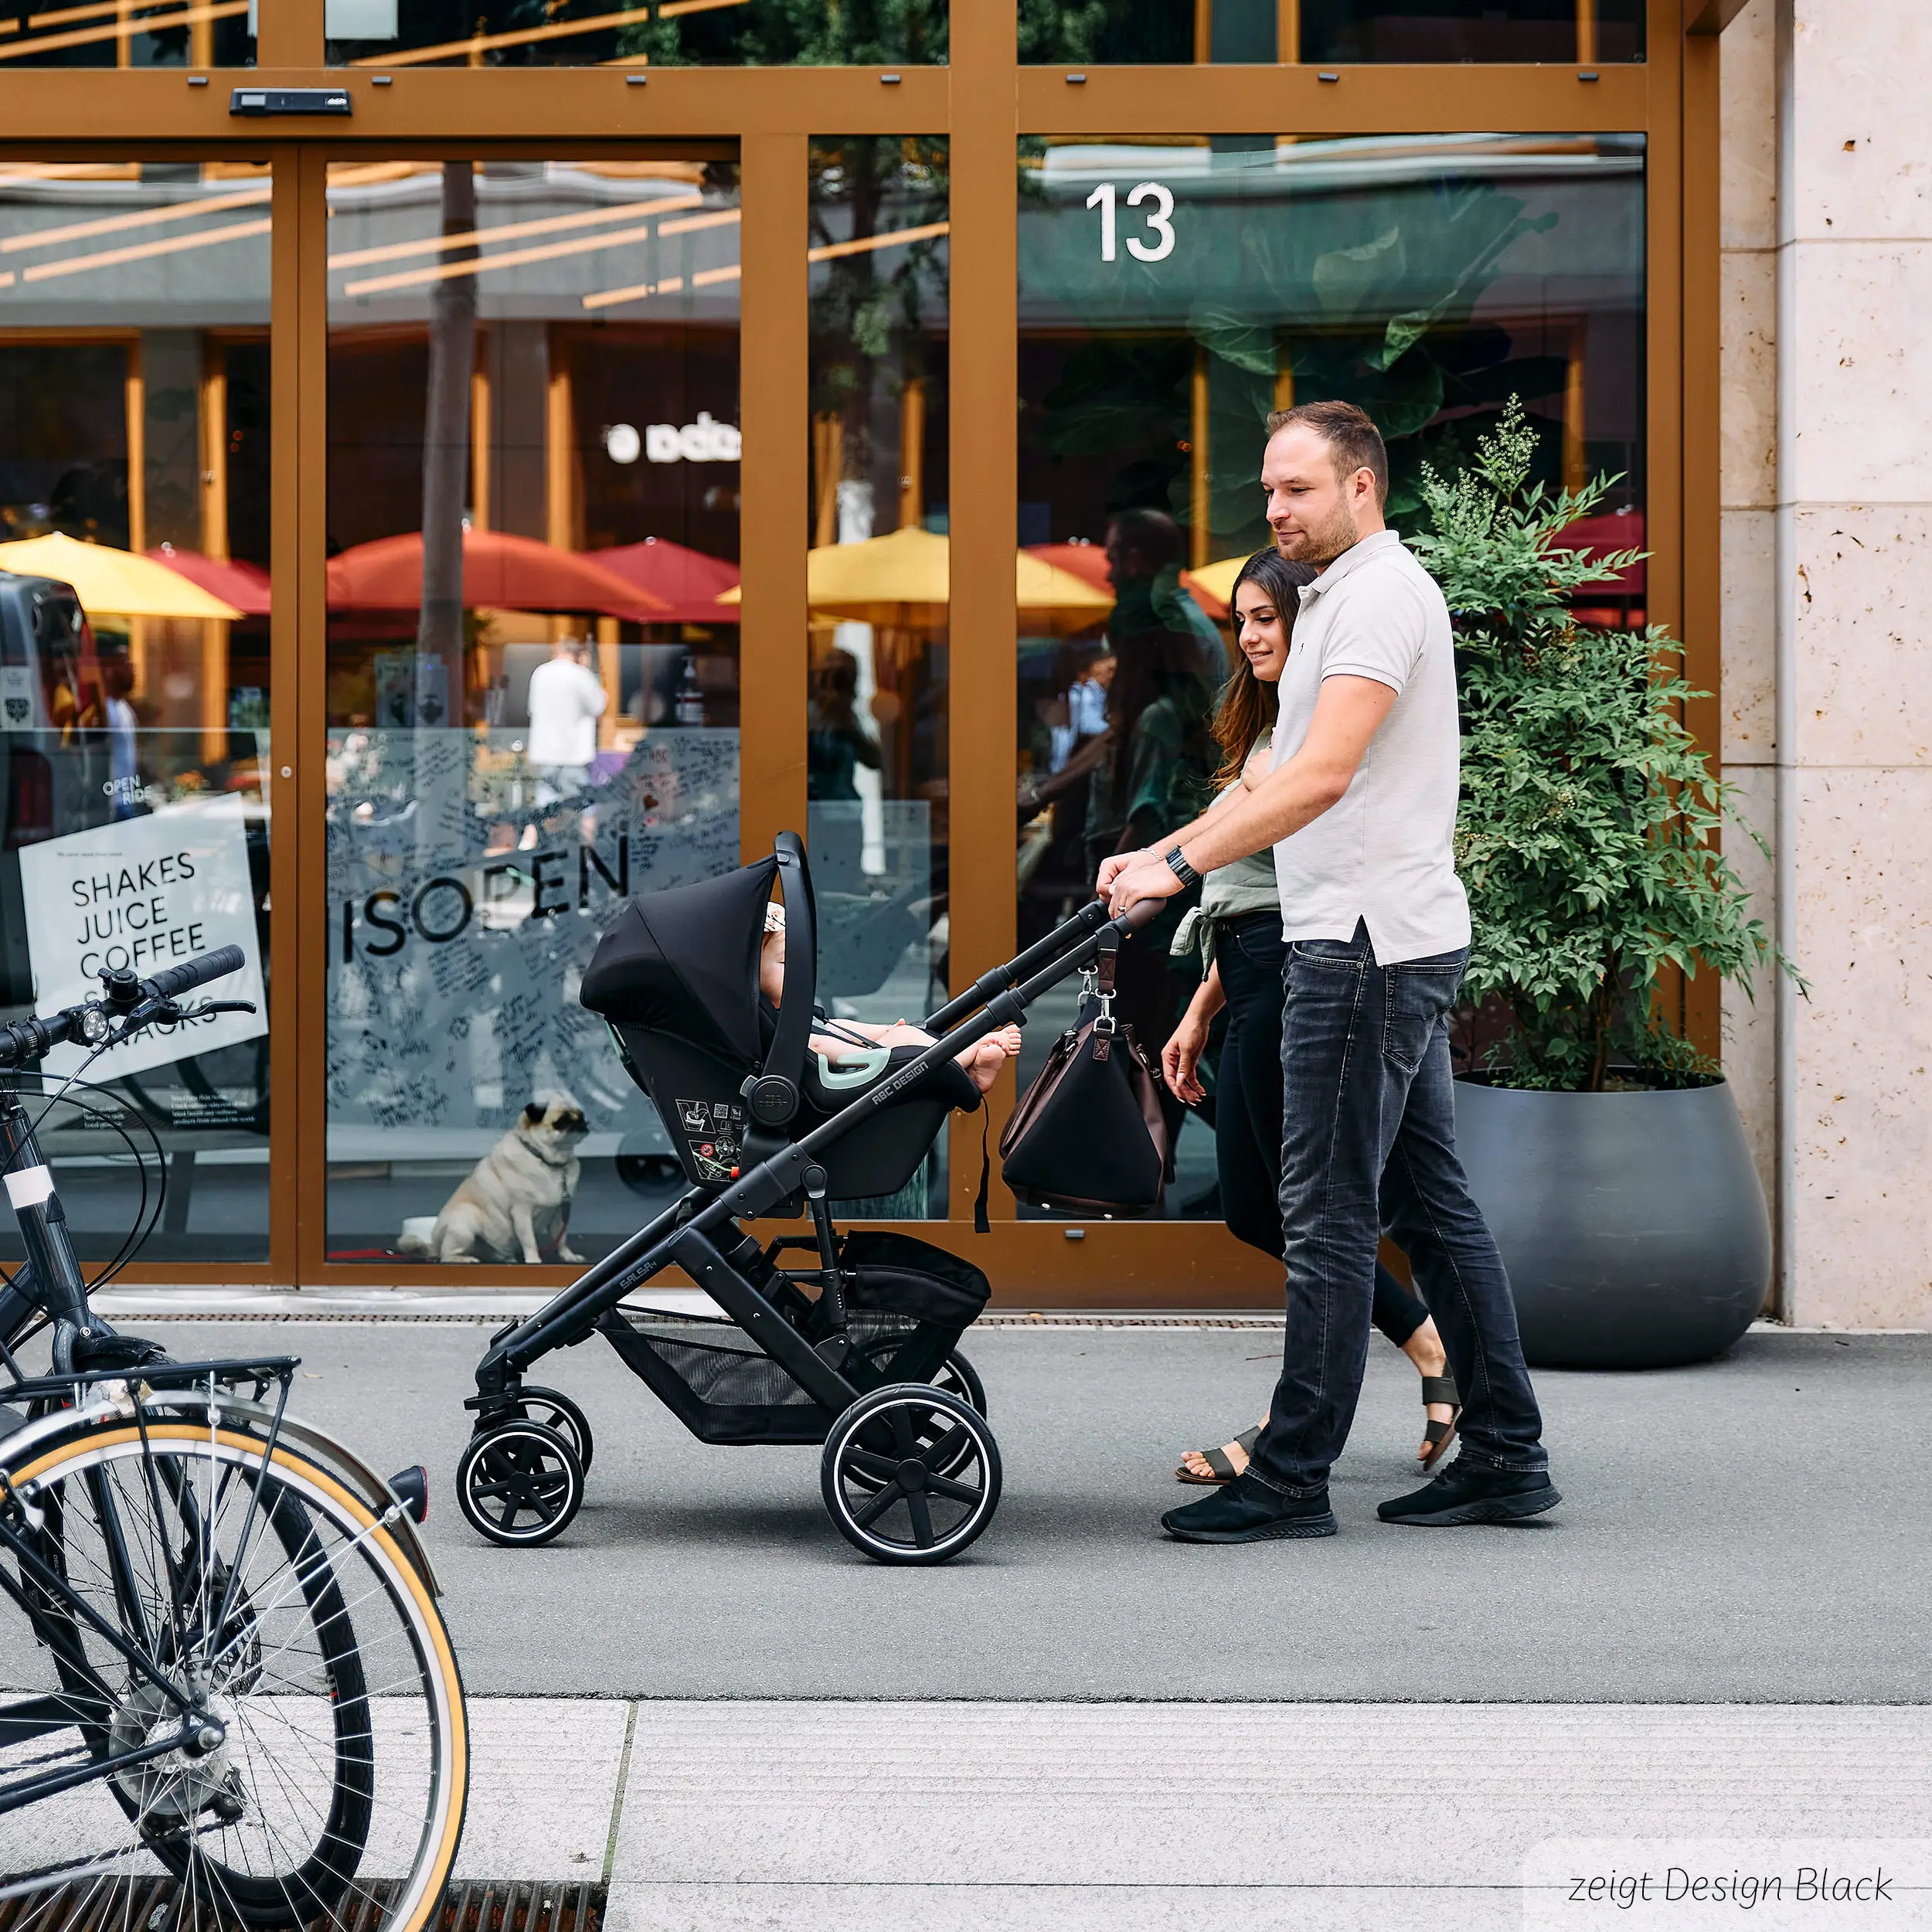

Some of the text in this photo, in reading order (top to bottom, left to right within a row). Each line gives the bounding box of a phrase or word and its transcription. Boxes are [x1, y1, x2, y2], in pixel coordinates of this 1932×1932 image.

[1085, 181, 1176, 263] 13
[103, 774, 141, 796] OPEN
[122, 785, 152, 805] RIDE
[72, 852, 196, 907] SHAKES
[77, 896, 168, 944] JUICE
[80, 922, 206, 980] COFFEE
[872, 1061, 929, 1105] ABC DESIGN
